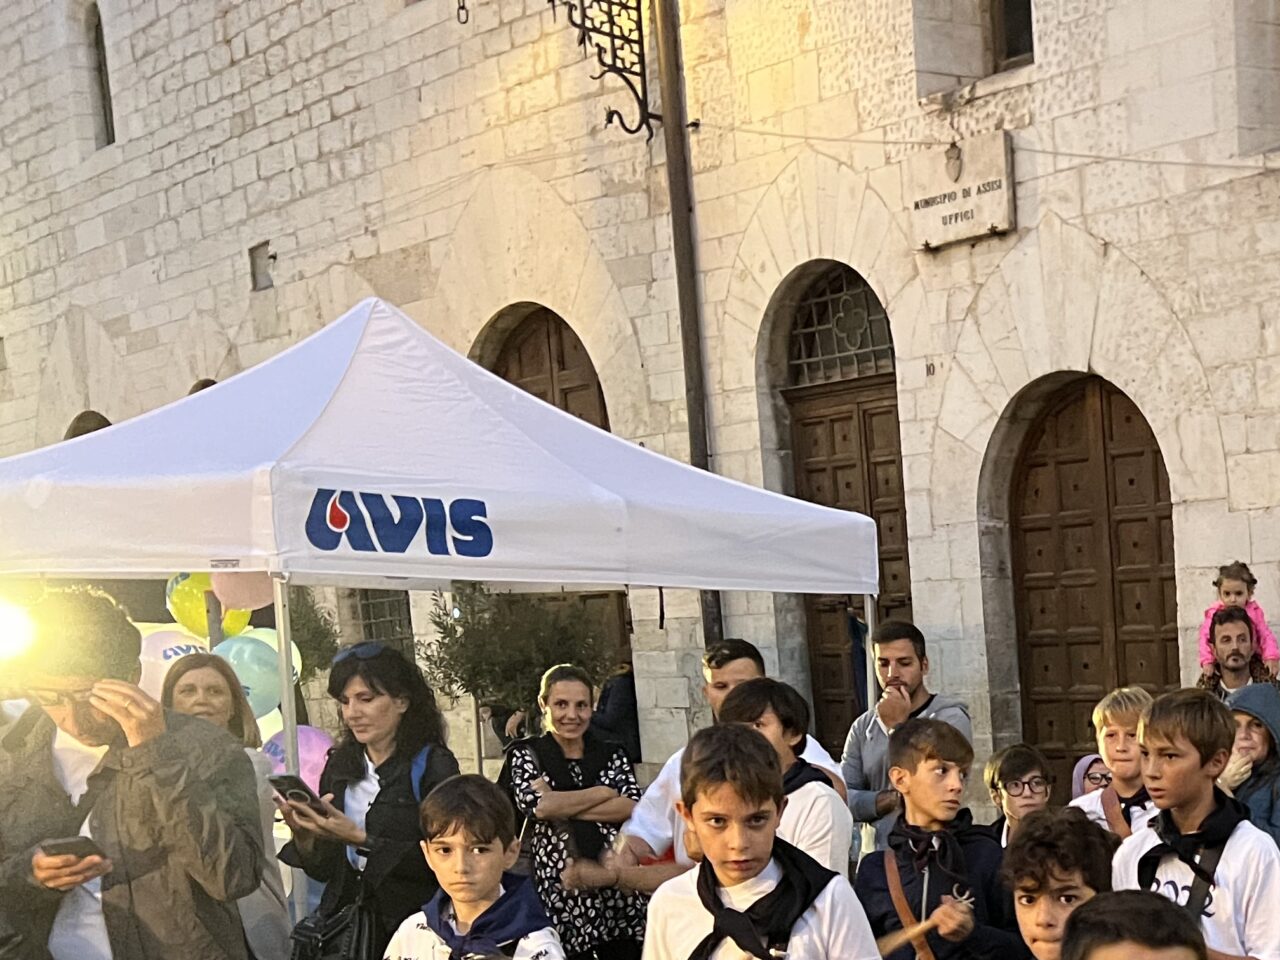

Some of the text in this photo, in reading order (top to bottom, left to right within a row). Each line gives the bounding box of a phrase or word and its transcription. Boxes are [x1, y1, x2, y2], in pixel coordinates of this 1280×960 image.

[914, 179, 1002, 210] MUNICIPIO DI ASSISI
[941, 209, 974, 226] UFFICI
[305, 488, 493, 557] AVIS
